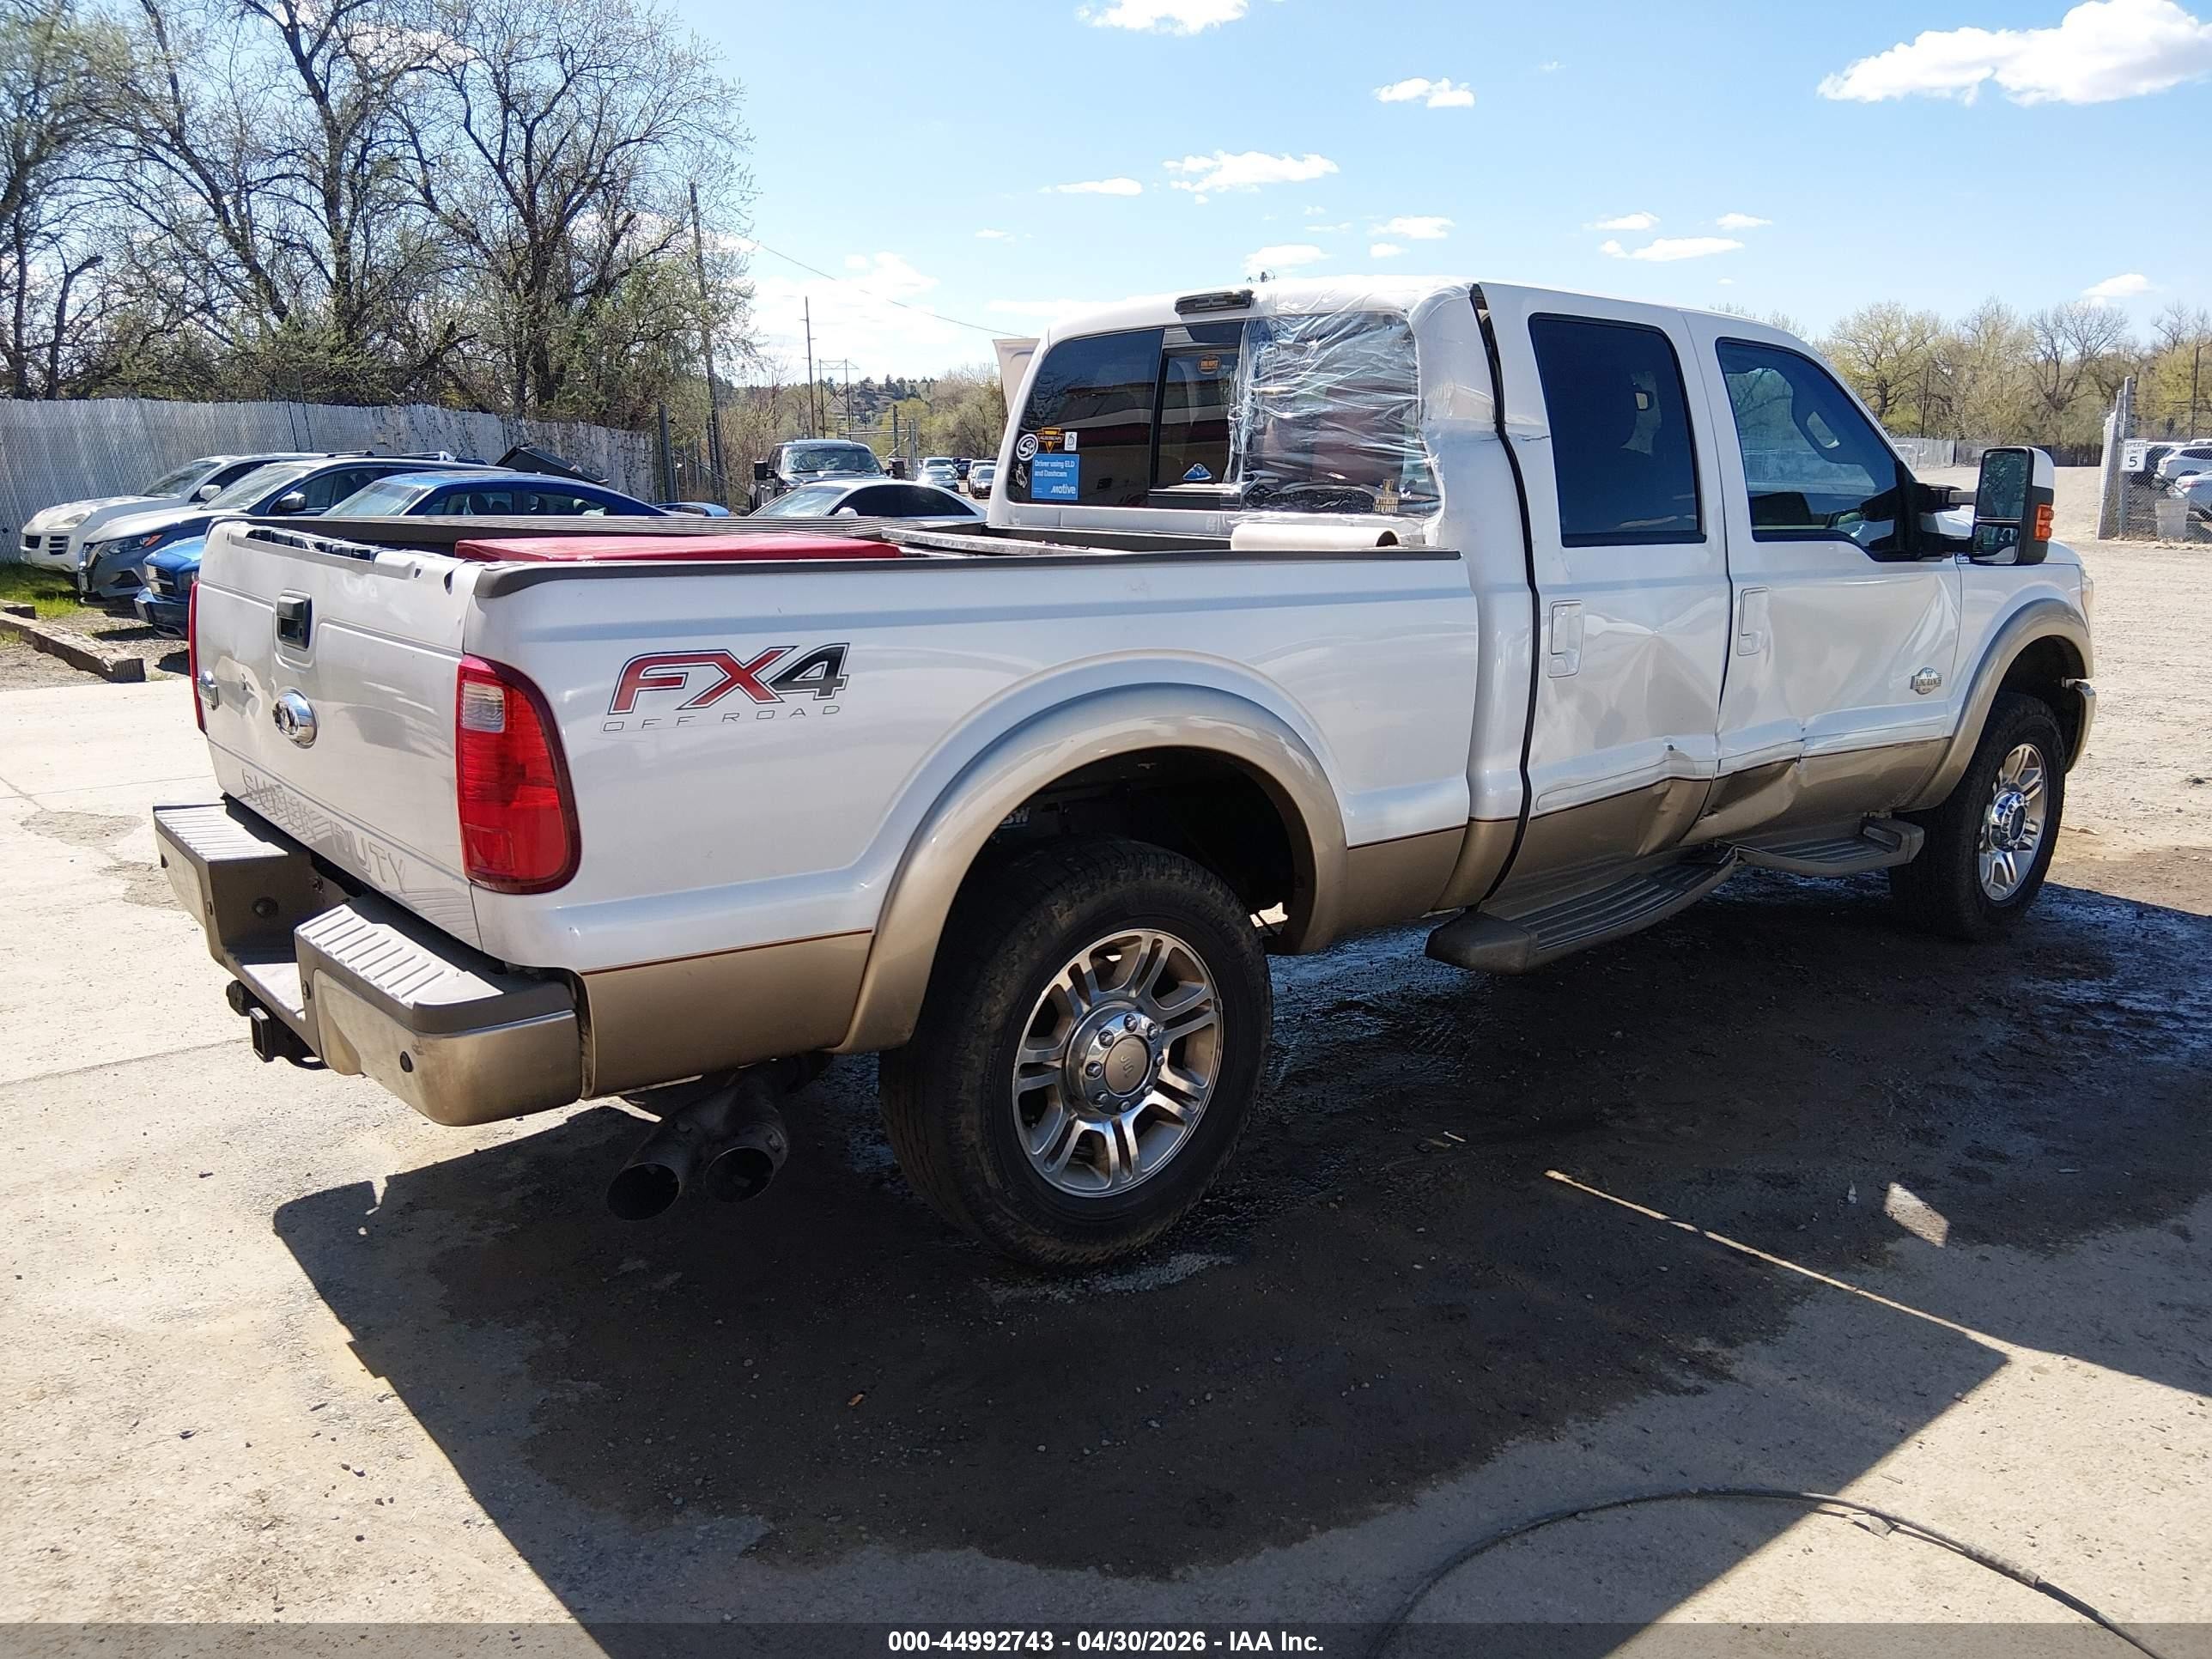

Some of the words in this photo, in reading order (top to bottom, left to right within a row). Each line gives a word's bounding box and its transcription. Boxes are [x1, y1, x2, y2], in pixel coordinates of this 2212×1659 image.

[1050, 460, 1064, 469] using
[2128, 456, 2138, 468] 5
[1050, 483, 1077, 495] Motive
[607, 642, 850, 716] FX4
[603, 714, 697, 732] OFF
[721, 705, 841, 724] ROAD
[329, 819, 406, 894] DUTY
